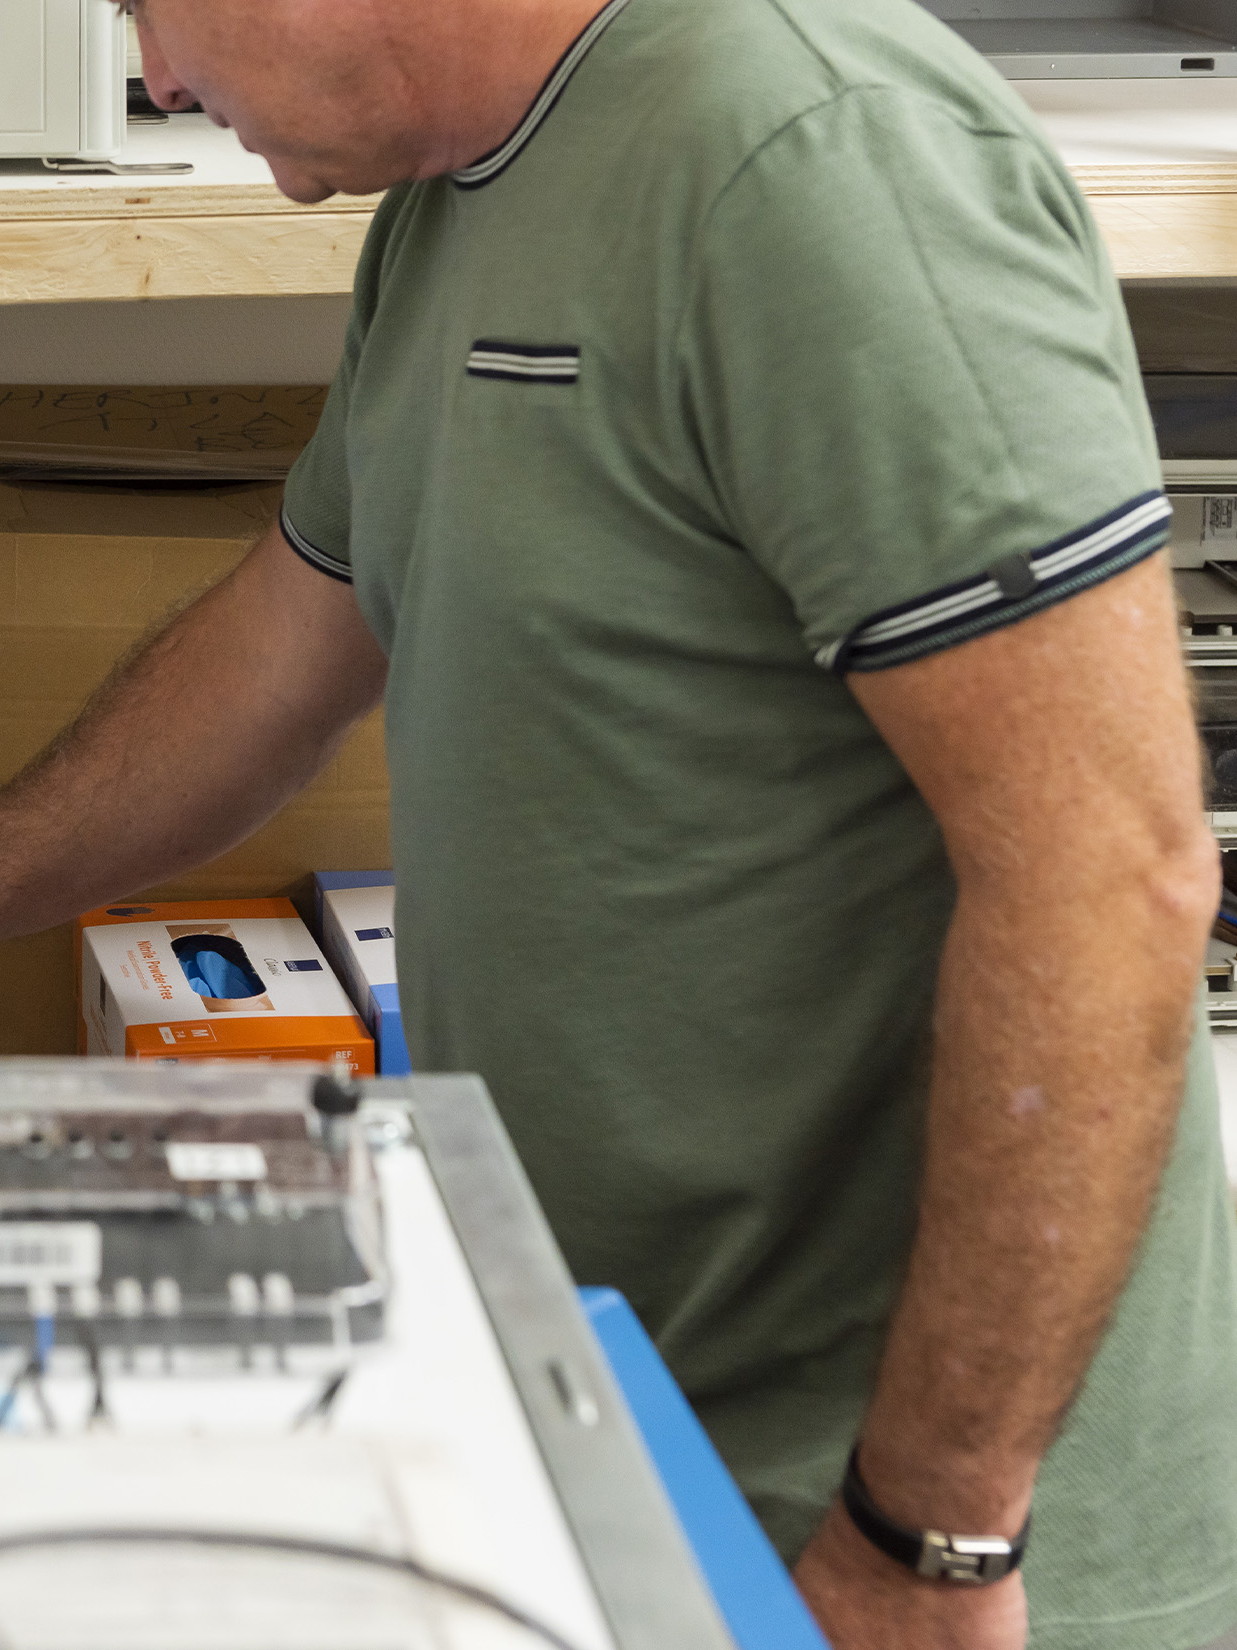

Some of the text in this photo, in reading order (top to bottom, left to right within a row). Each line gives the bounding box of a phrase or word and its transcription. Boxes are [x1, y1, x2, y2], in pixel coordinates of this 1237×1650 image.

[137, 941, 173, 1000] Nitrile Powder-Free
[191, 1029, 209, 1038] M
[335, 1051, 352, 1059] REF
